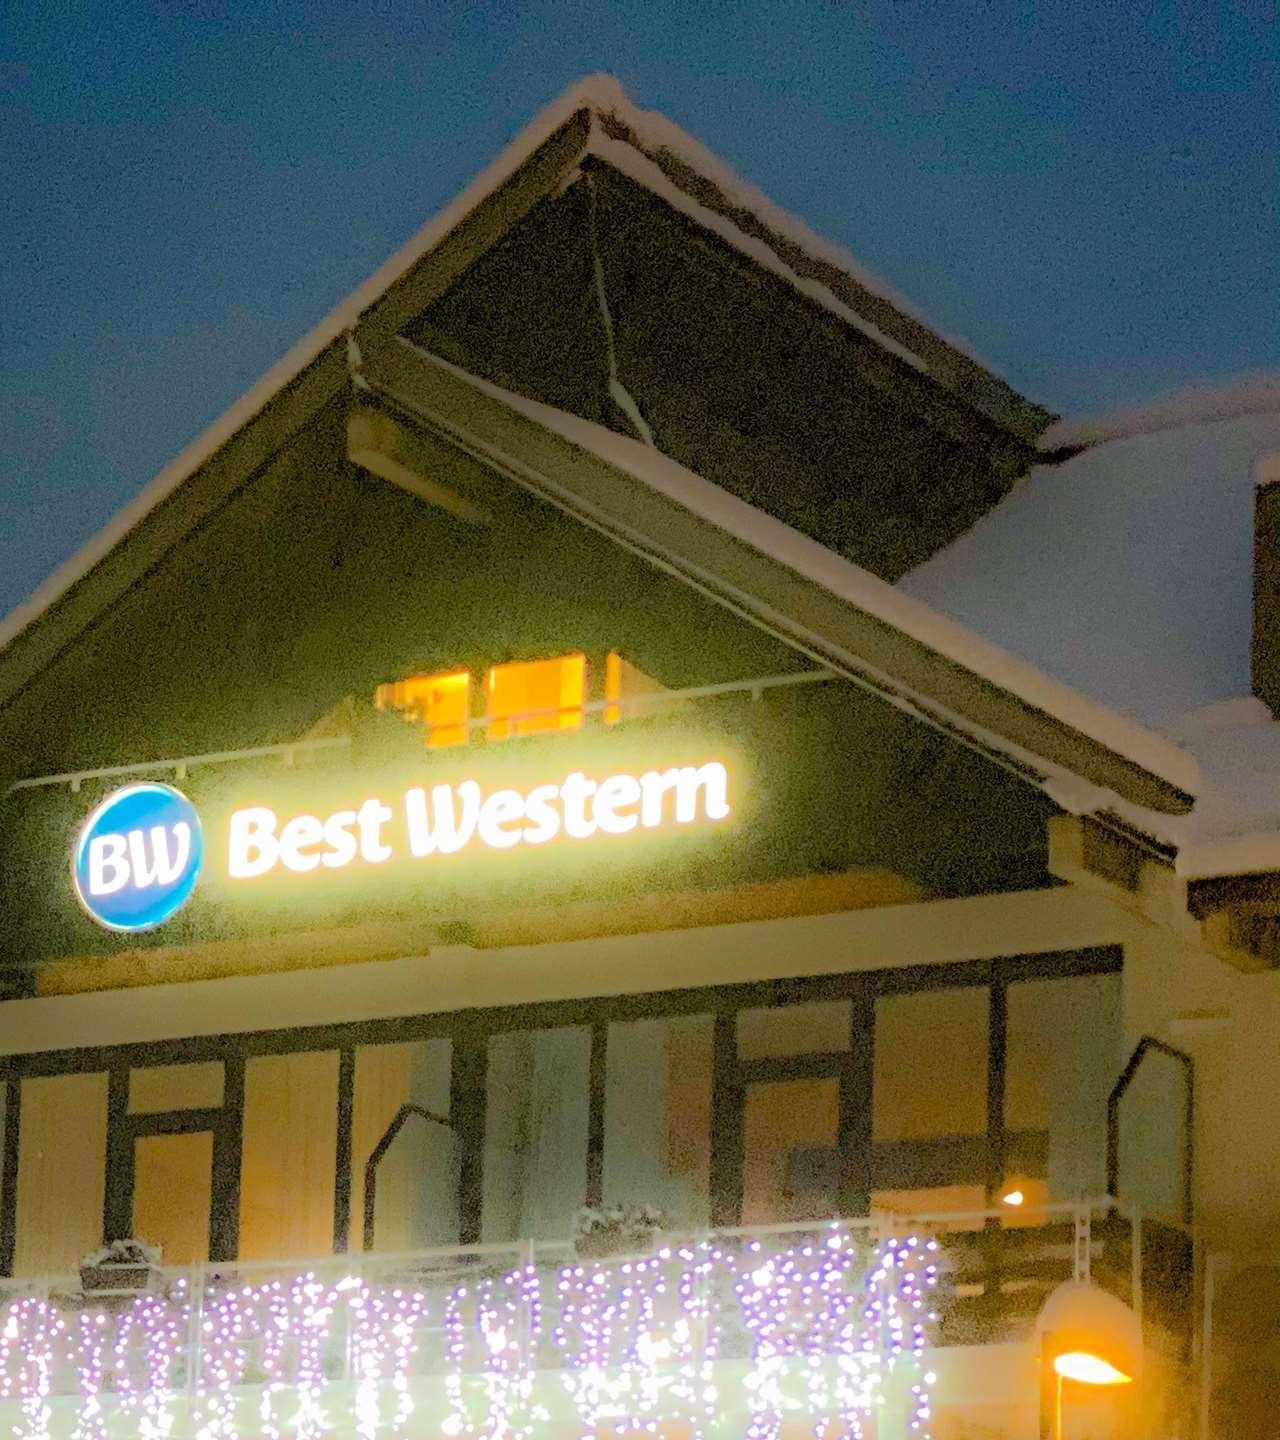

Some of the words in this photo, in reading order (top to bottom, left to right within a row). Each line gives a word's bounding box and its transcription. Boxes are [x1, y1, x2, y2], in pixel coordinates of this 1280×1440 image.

[88, 821, 191, 897] BW
[227, 798, 391, 879] Best
[404, 760, 730, 858] Western
